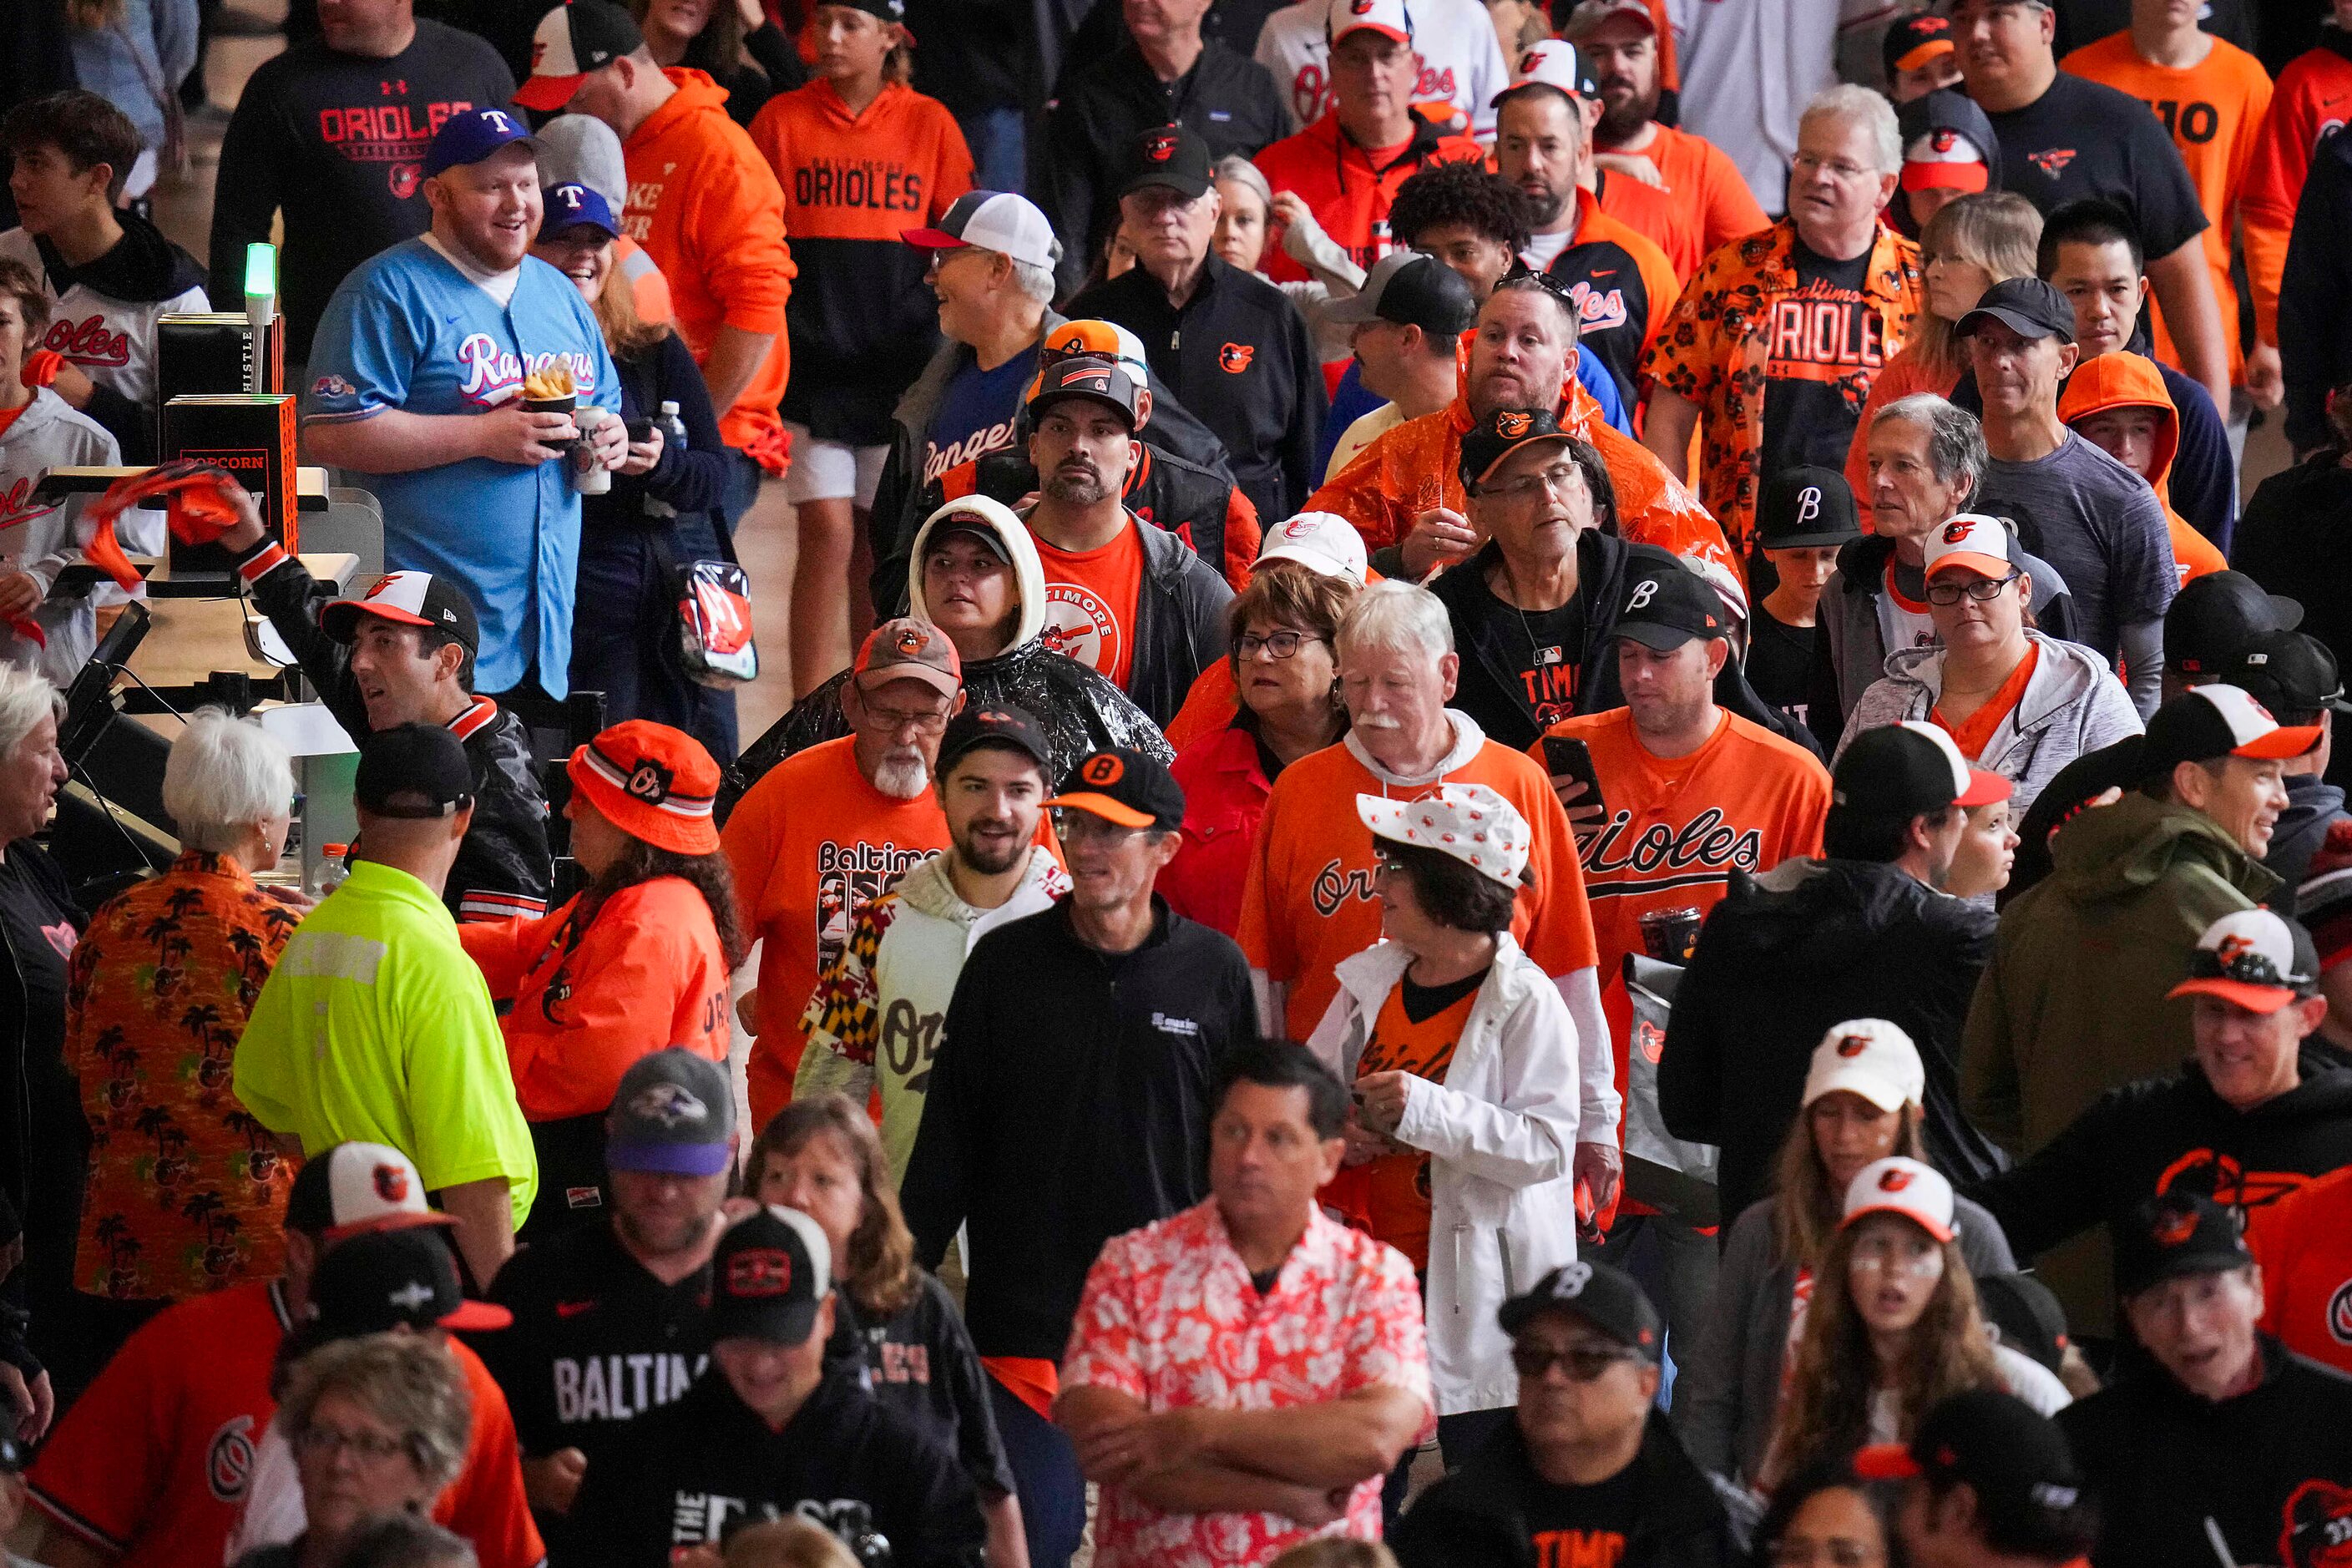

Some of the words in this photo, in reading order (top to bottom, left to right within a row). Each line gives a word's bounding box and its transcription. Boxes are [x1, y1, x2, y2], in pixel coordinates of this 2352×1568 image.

[321, 101, 473, 142] ORIOLE
[480, 110, 508, 134] T
[557, 185, 584, 208] T
[795, 167, 922, 211] ORIOLES
[1769, 301, 1882, 367] RIOLE
[1797, 487, 1822, 524] B
[1625, 579, 1659, 614] B
[1090, 758, 1115, 780] B
